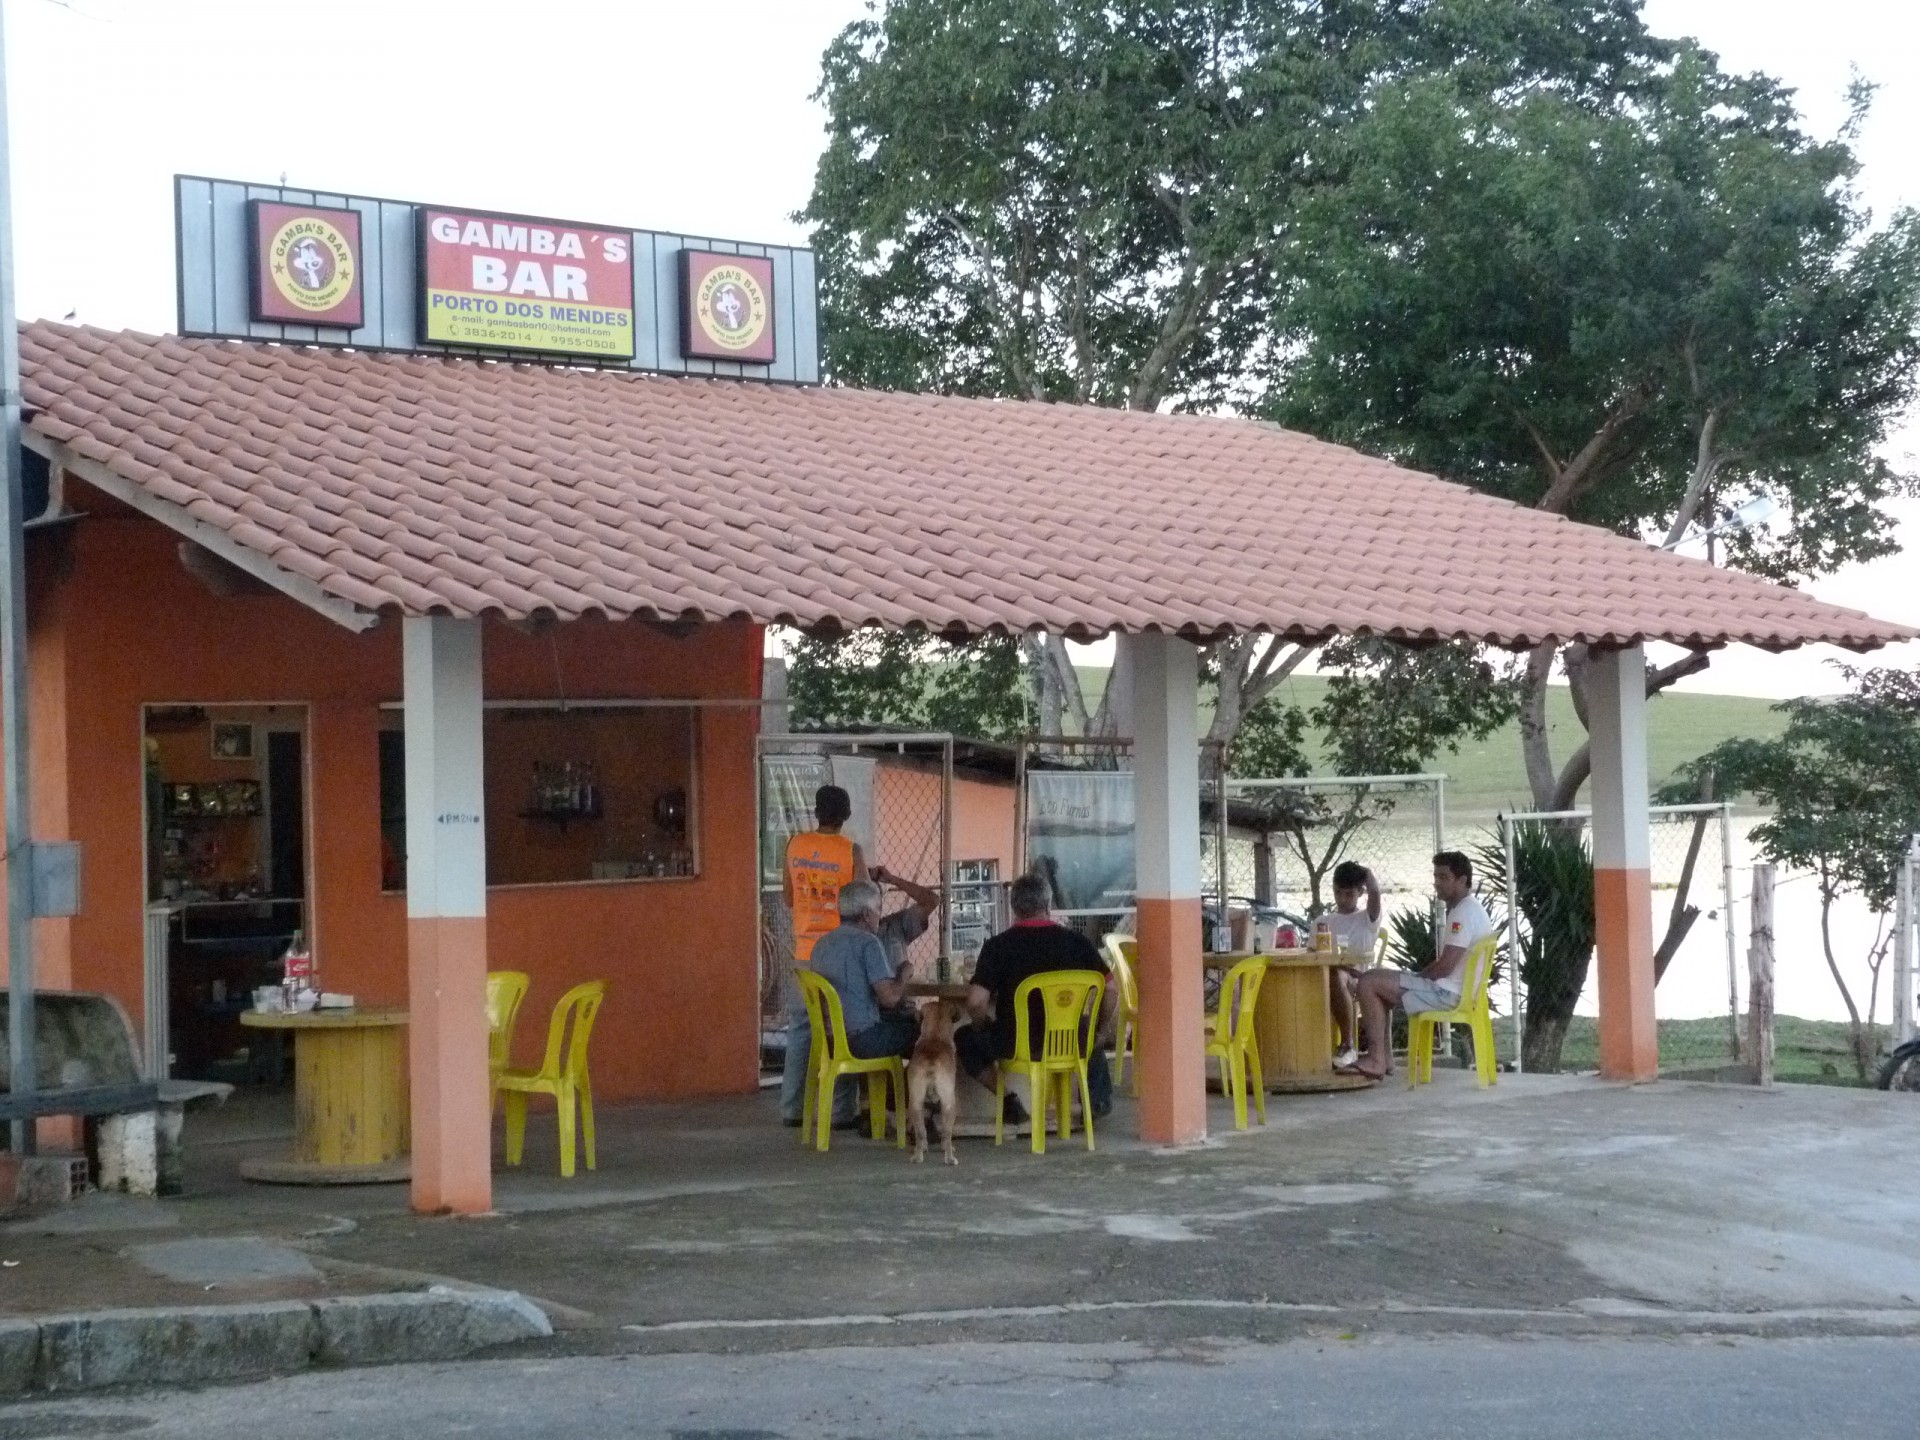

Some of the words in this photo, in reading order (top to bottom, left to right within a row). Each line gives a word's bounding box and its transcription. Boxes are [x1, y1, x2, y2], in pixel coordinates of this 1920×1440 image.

[276, 223, 324, 257] GAMBA'S
[327, 233, 348, 262] BAR
[472, 255, 588, 301] BAR
[702, 271, 741, 301] GAMBA'S
[744, 279, 761, 305] BAR
[432, 294, 498, 314] PORTO
[505, 302, 544, 319] DOS
[550, 306, 628, 327] MENDES
[451, 314, 484, 325] e-mail:
[487, 317, 611, 337] gambasbar10@hotmail.com
[464, 327, 532, 342] 3836-2014
[551, 336, 616, 350] 9955-0508
[1060, 798, 1090, 818] Furnas
